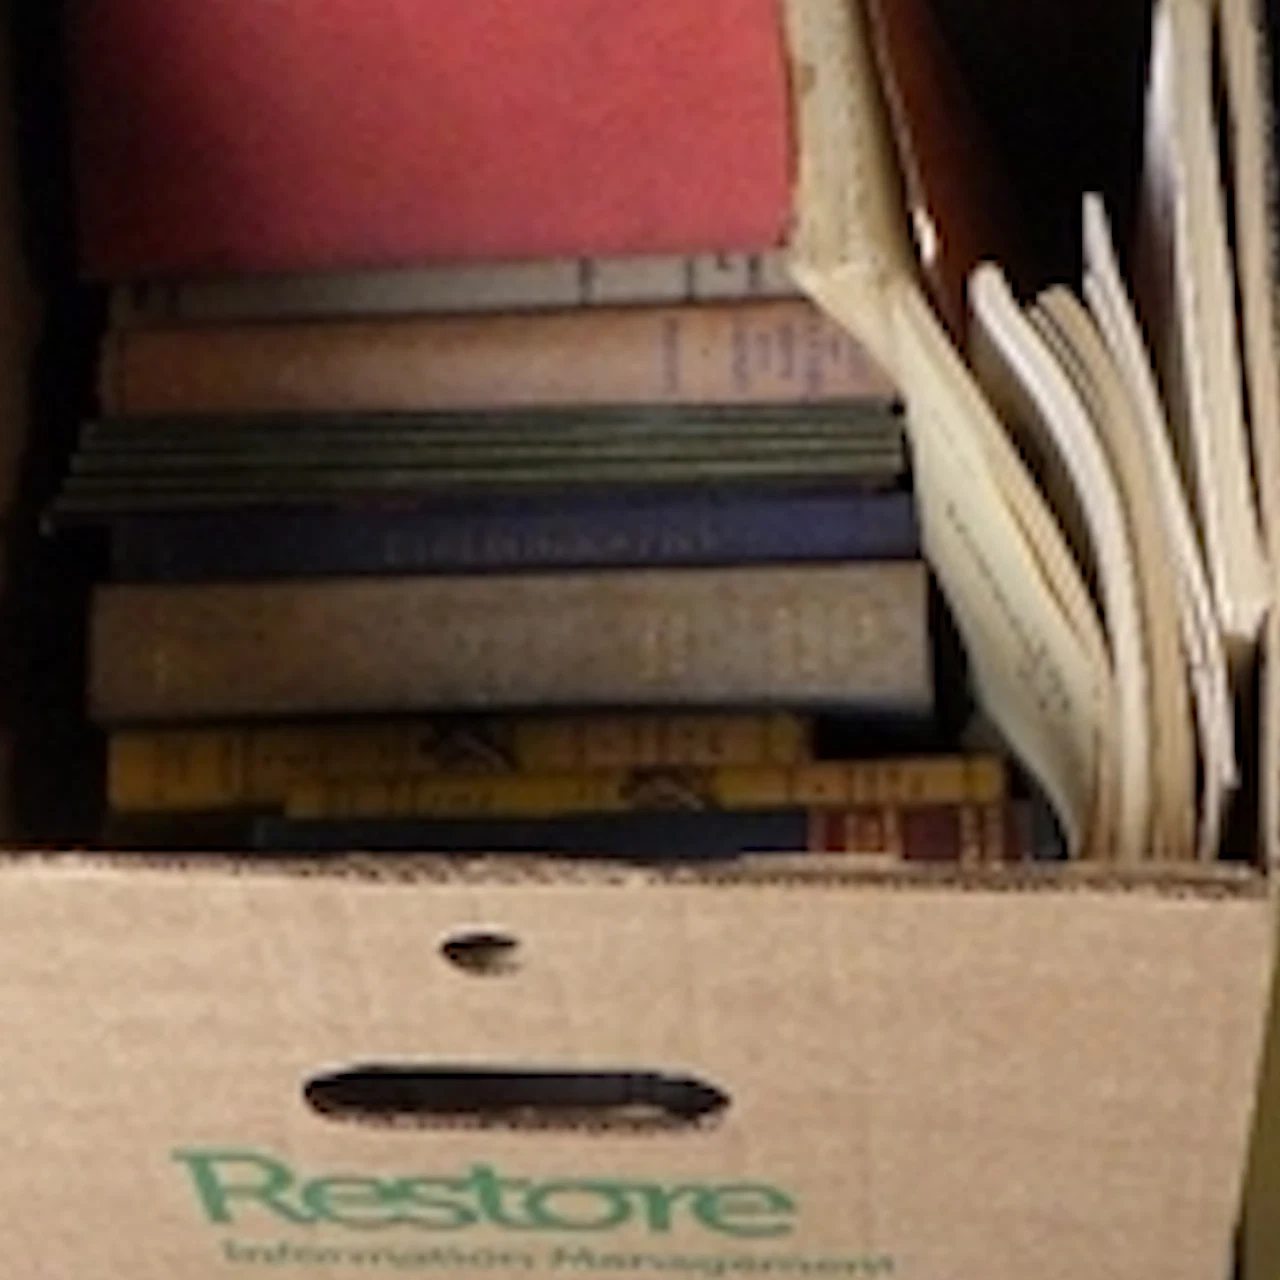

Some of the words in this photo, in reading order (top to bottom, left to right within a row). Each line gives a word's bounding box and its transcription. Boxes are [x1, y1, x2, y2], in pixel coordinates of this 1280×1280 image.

[172, 1146, 798, 1238] Restore
[222, 1239, 536, 1272] Information
[548, 1242, 897, 1280] Management
